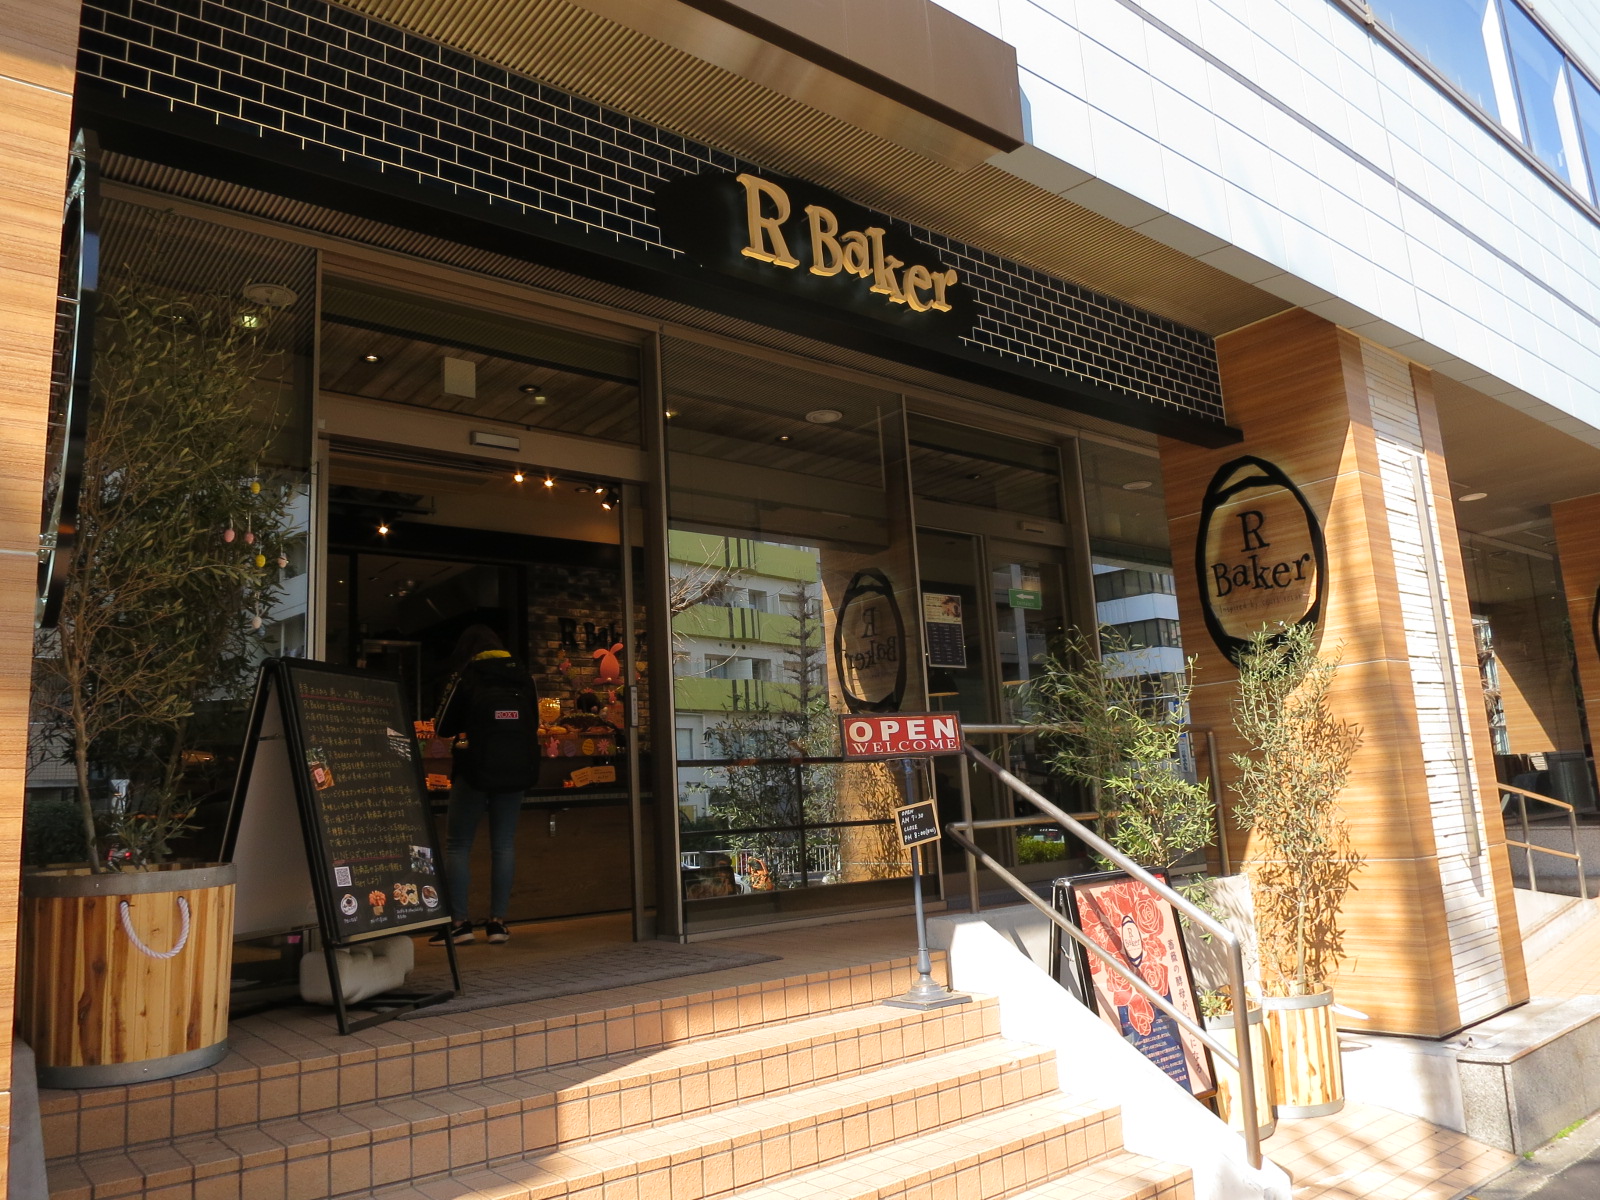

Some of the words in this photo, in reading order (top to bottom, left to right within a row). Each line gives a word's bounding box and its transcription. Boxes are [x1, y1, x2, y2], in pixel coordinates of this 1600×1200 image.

[736, 173, 800, 269] R
[804, 204, 958, 313] Baker
[1236, 510, 1270, 552] R
[1210, 552, 1311, 597] Baker
[496, 711, 518, 719] ROXY
[849, 719, 956, 742] OPEN
[852, 738, 957, 754] WELCOME
